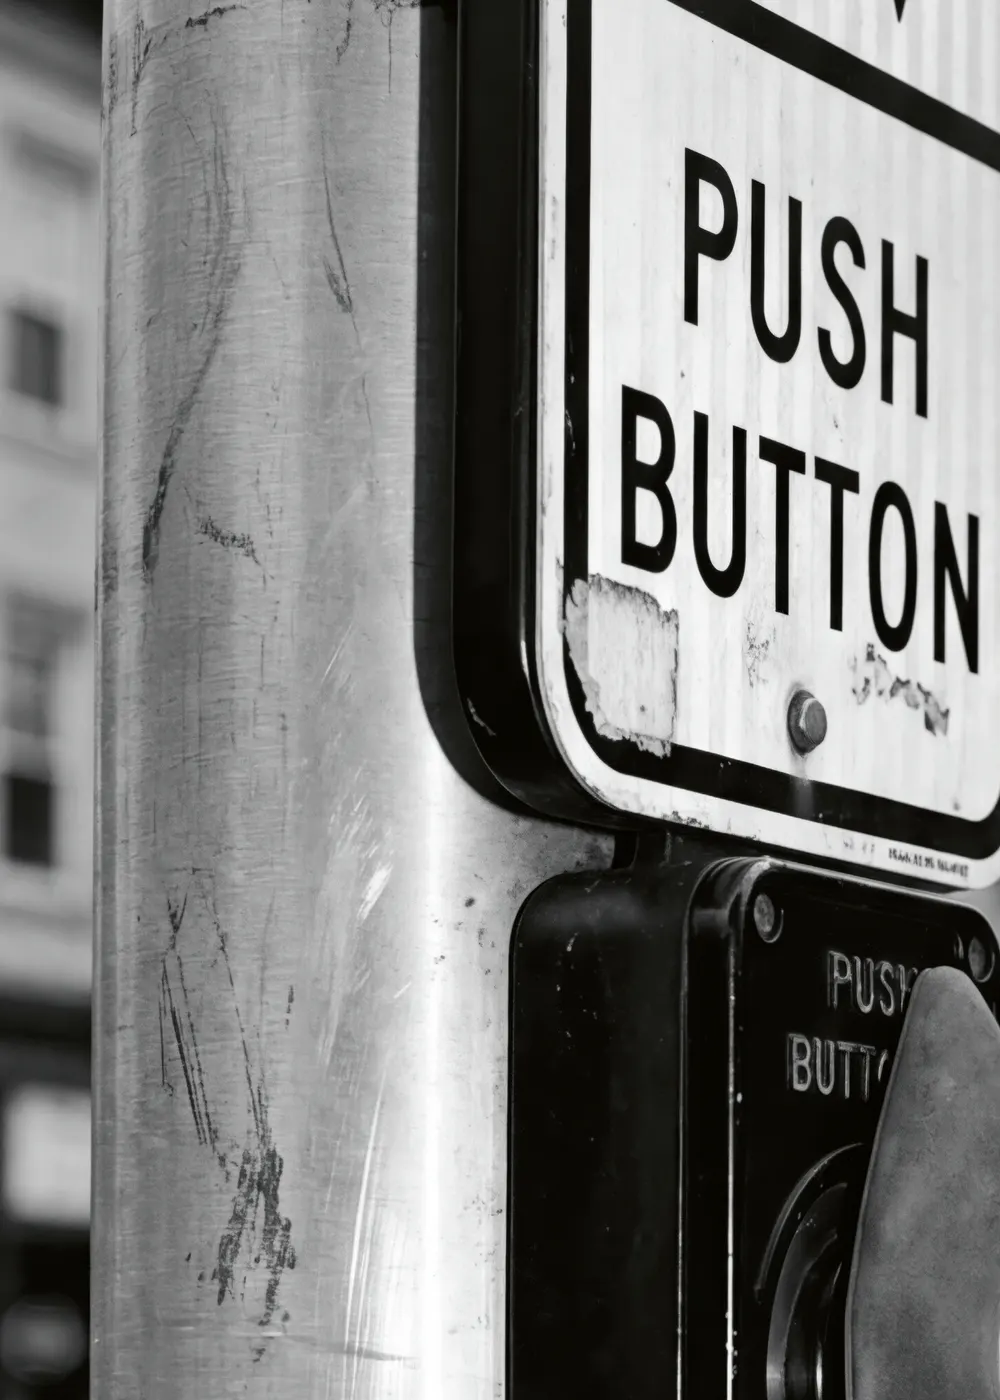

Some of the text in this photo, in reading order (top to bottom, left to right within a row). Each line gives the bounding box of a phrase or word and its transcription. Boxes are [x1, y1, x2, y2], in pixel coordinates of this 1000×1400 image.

[684, 147, 929, 418] PUSH
[621, 384, 979, 674] BUTTON
[786, 1033, 888, 1102] BUTT
